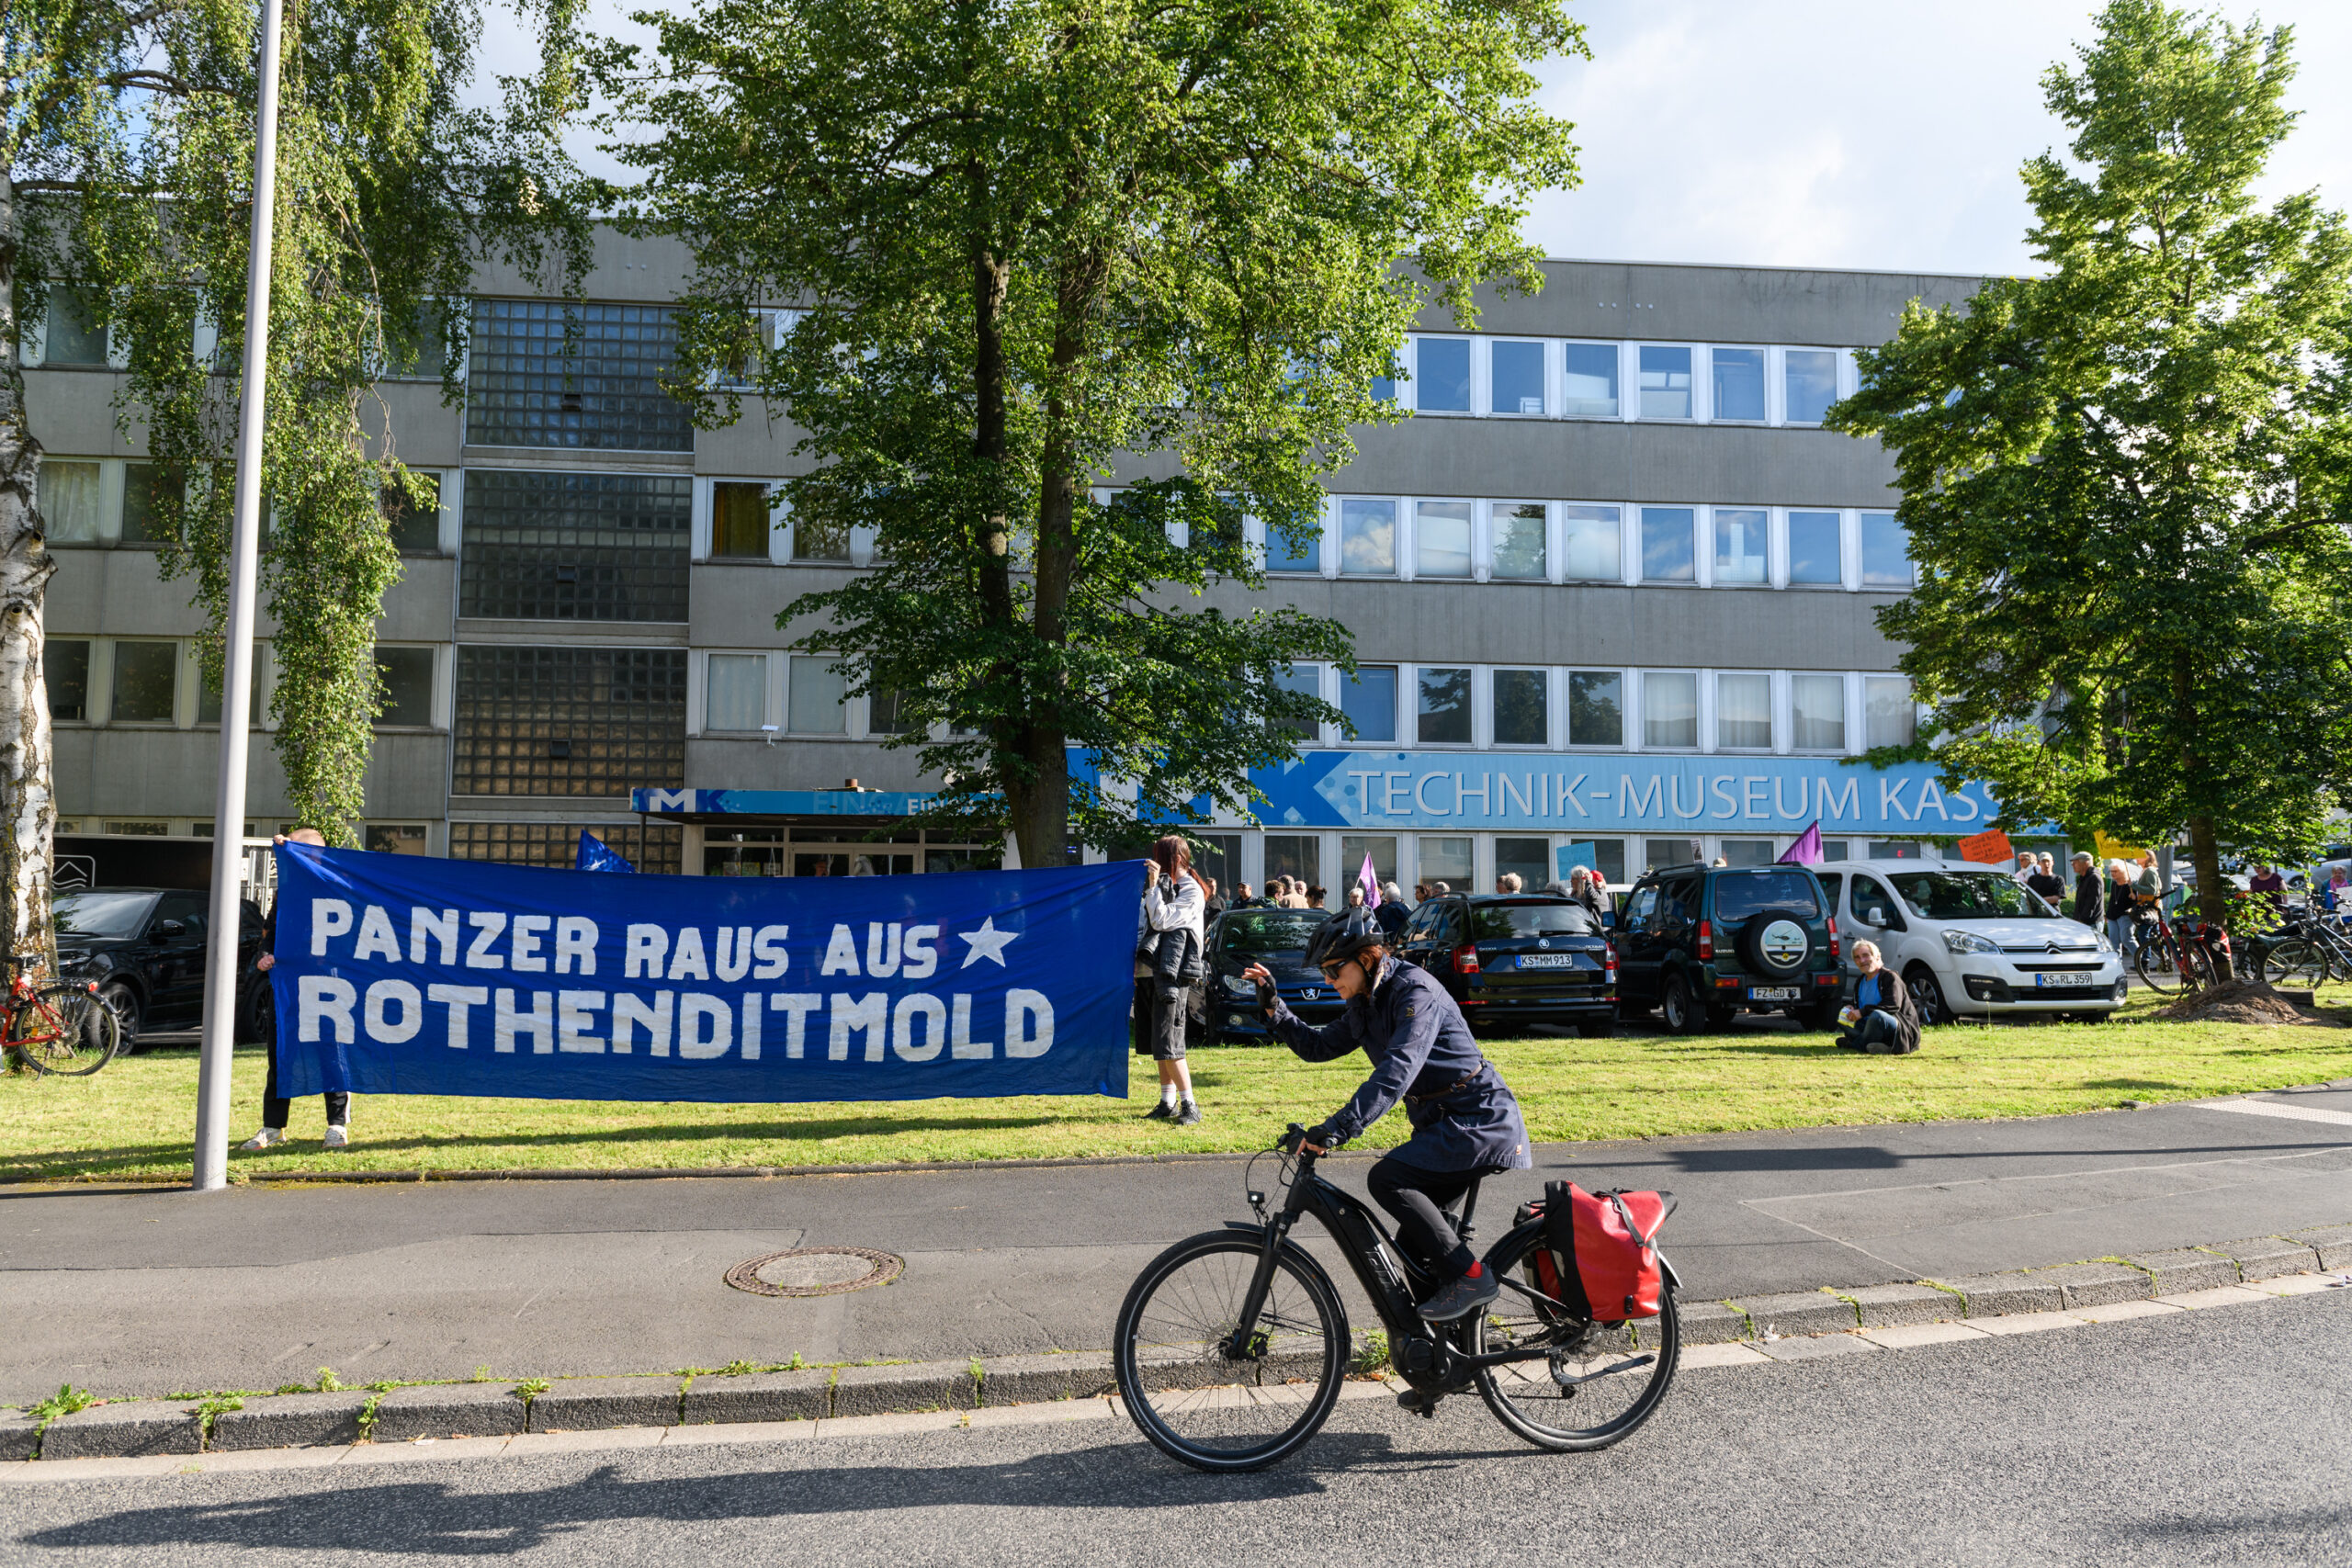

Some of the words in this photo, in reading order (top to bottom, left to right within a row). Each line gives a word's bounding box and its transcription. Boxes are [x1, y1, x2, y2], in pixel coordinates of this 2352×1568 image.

[1347, 770, 1861, 820] TECHNIK-MUSEUM
[1880, 778, 2056, 823] KASS
[310, 897, 599, 976] PANZER
[624, 923, 789, 981] RAUS
[820, 921, 941, 979] AUS
[1521, 955, 1534, 965] KS
[1540, 955, 1553, 965] MM
[1554, 954, 1571, 964] 913
[1756, 988, 1768, 998] FZ
[1773, 988, 1785, 998] GD
[2042, 975, 2054, 985] KS
[2060, 975, 2073, 985] RL
[2074, 975, 2090, 984] 359
[298, 975, 1055, 1063] ROTHENDITMOLD
